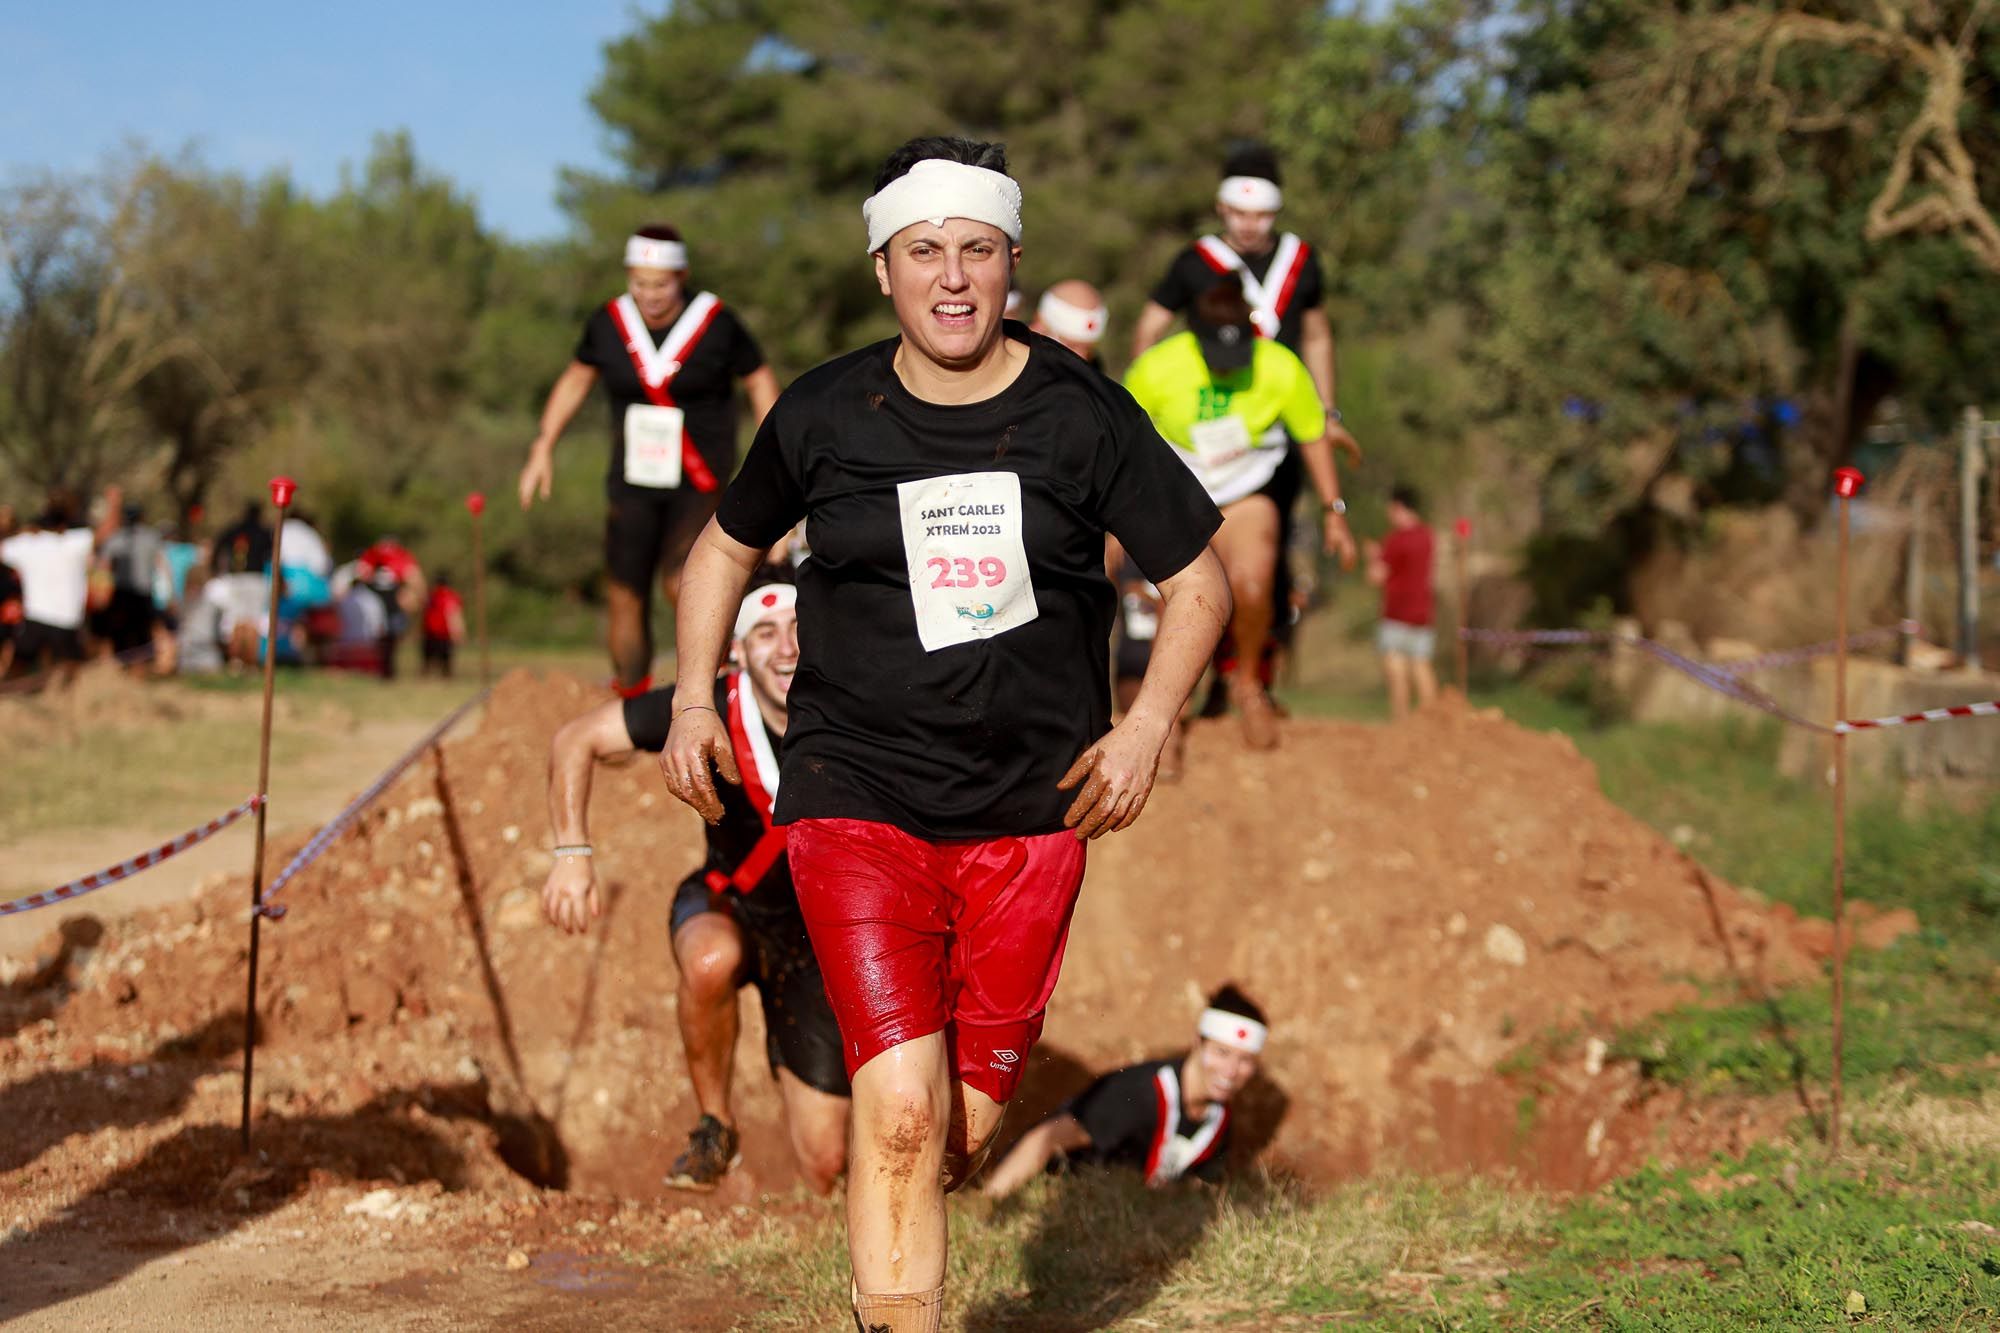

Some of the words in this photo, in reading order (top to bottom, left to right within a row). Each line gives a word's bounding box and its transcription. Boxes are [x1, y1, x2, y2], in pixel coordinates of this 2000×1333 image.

[921, 507, 955, 520] SANT
[958, 504, 1005, 516] CARLES
[926, 524, 969, 536] XTREM
[972, 525, 1001, 535] 2023
[926, 557, 1007, 589] 239
